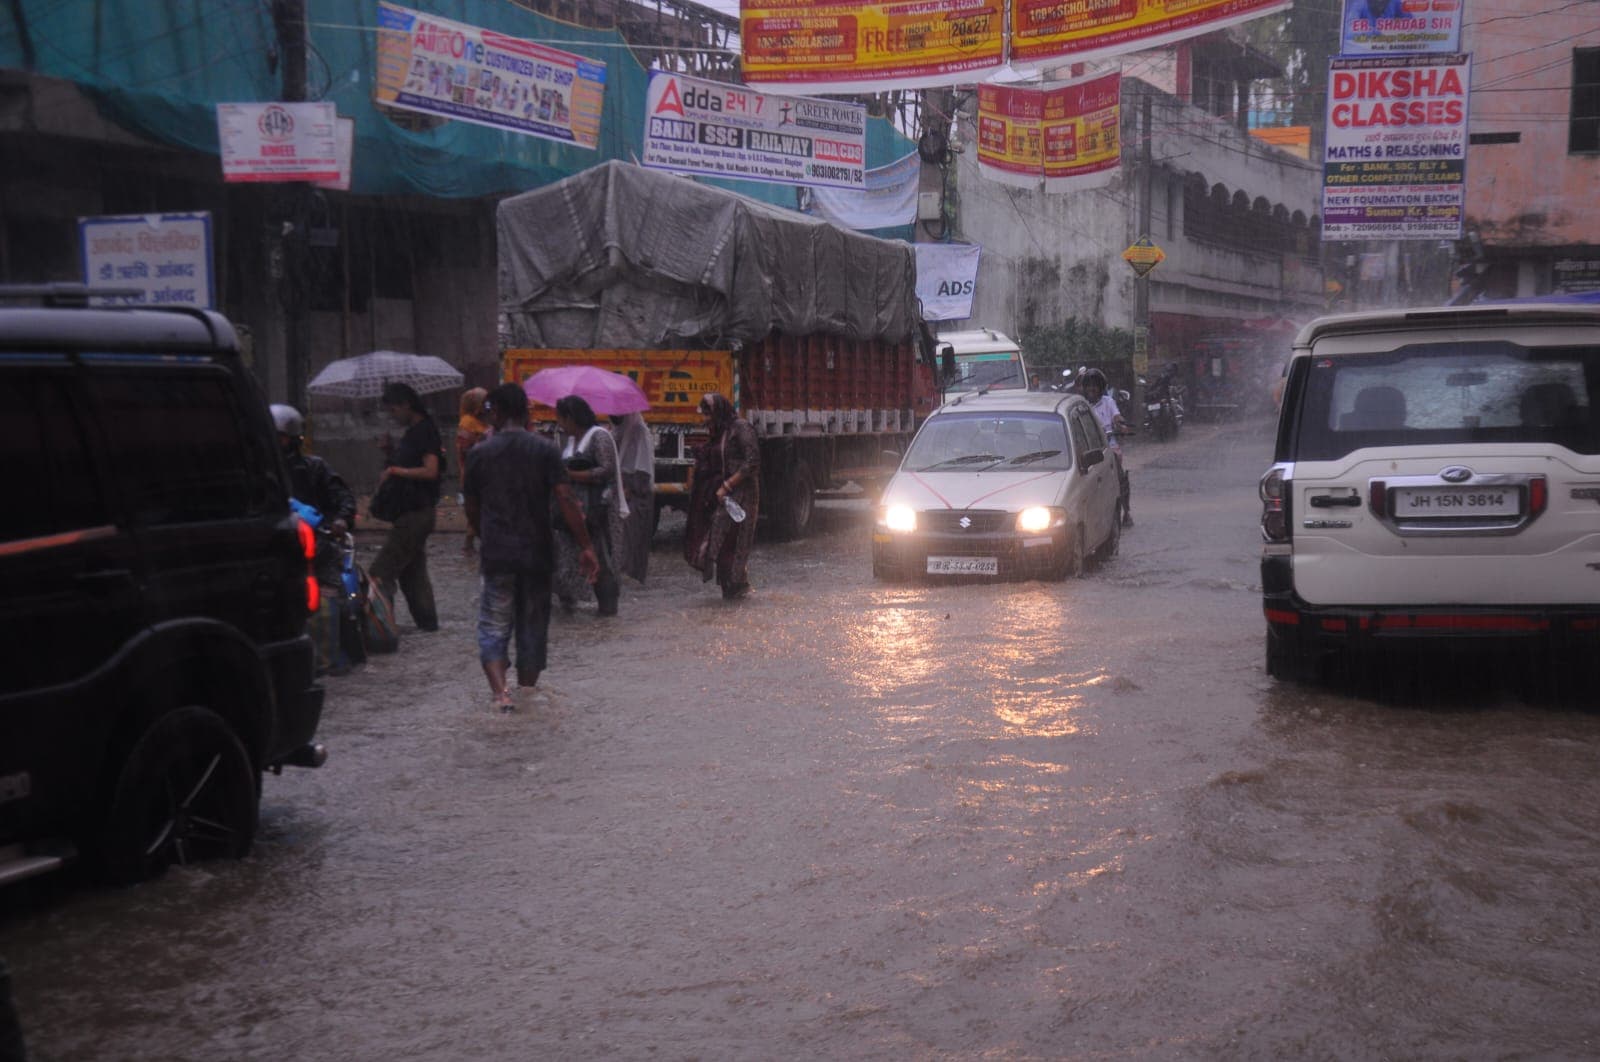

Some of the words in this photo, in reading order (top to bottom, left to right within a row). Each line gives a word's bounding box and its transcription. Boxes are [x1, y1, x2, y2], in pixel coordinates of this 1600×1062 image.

[1377, 18, 1427, 31] SHADAB
[1431, 17, 1452, 29] SIR
[865, 29, 904, 53] FREE
[486, 50, 534, 77] CUSTOMIZED
[536, 63, 552, 81] GIFT
[553, 68, 574, 86] SHOP
[1333, 69, 1464, 100] DIKSHA
[655, 78, 722, 117] Adda
[795, 101, 831, 121] CAREER
[831, 107, 863, 124] POWER
[1331, 100, 1463, 128] CLASSES
[651, 118, 694, 141] BANK
[704, 125, 738, 146] SSC
[751, 131, 809, 156] RAILWAY
[1327, 146, 1371, 158] MATHS
[1374, 146, 1383, 157] &
[1386, 143, 1460, 157] REASONING
[1327, 175, 1359, 183] OTHER
[1361, 173, 1425, 183] COMPETITIVE
[1427, 172, 1461, 181] EXAMS
[1327, 196, 1350, 205] NEW
[1354, 195, 1421, 204] FOUNDATION
[1424, 194, 1459, 203] BATCH
[1366, 207, 1404, 217] Suman
[1407, 206, 1424, 217] Kr.
[1427, 205, 1459, 217] Singh
[938, 280, 973, 296] ADS
[1410, 495, 1431, 507] JH
[1433, 495, 1464, 507] 15N
[1468, 493, 1504, 506] 3614
